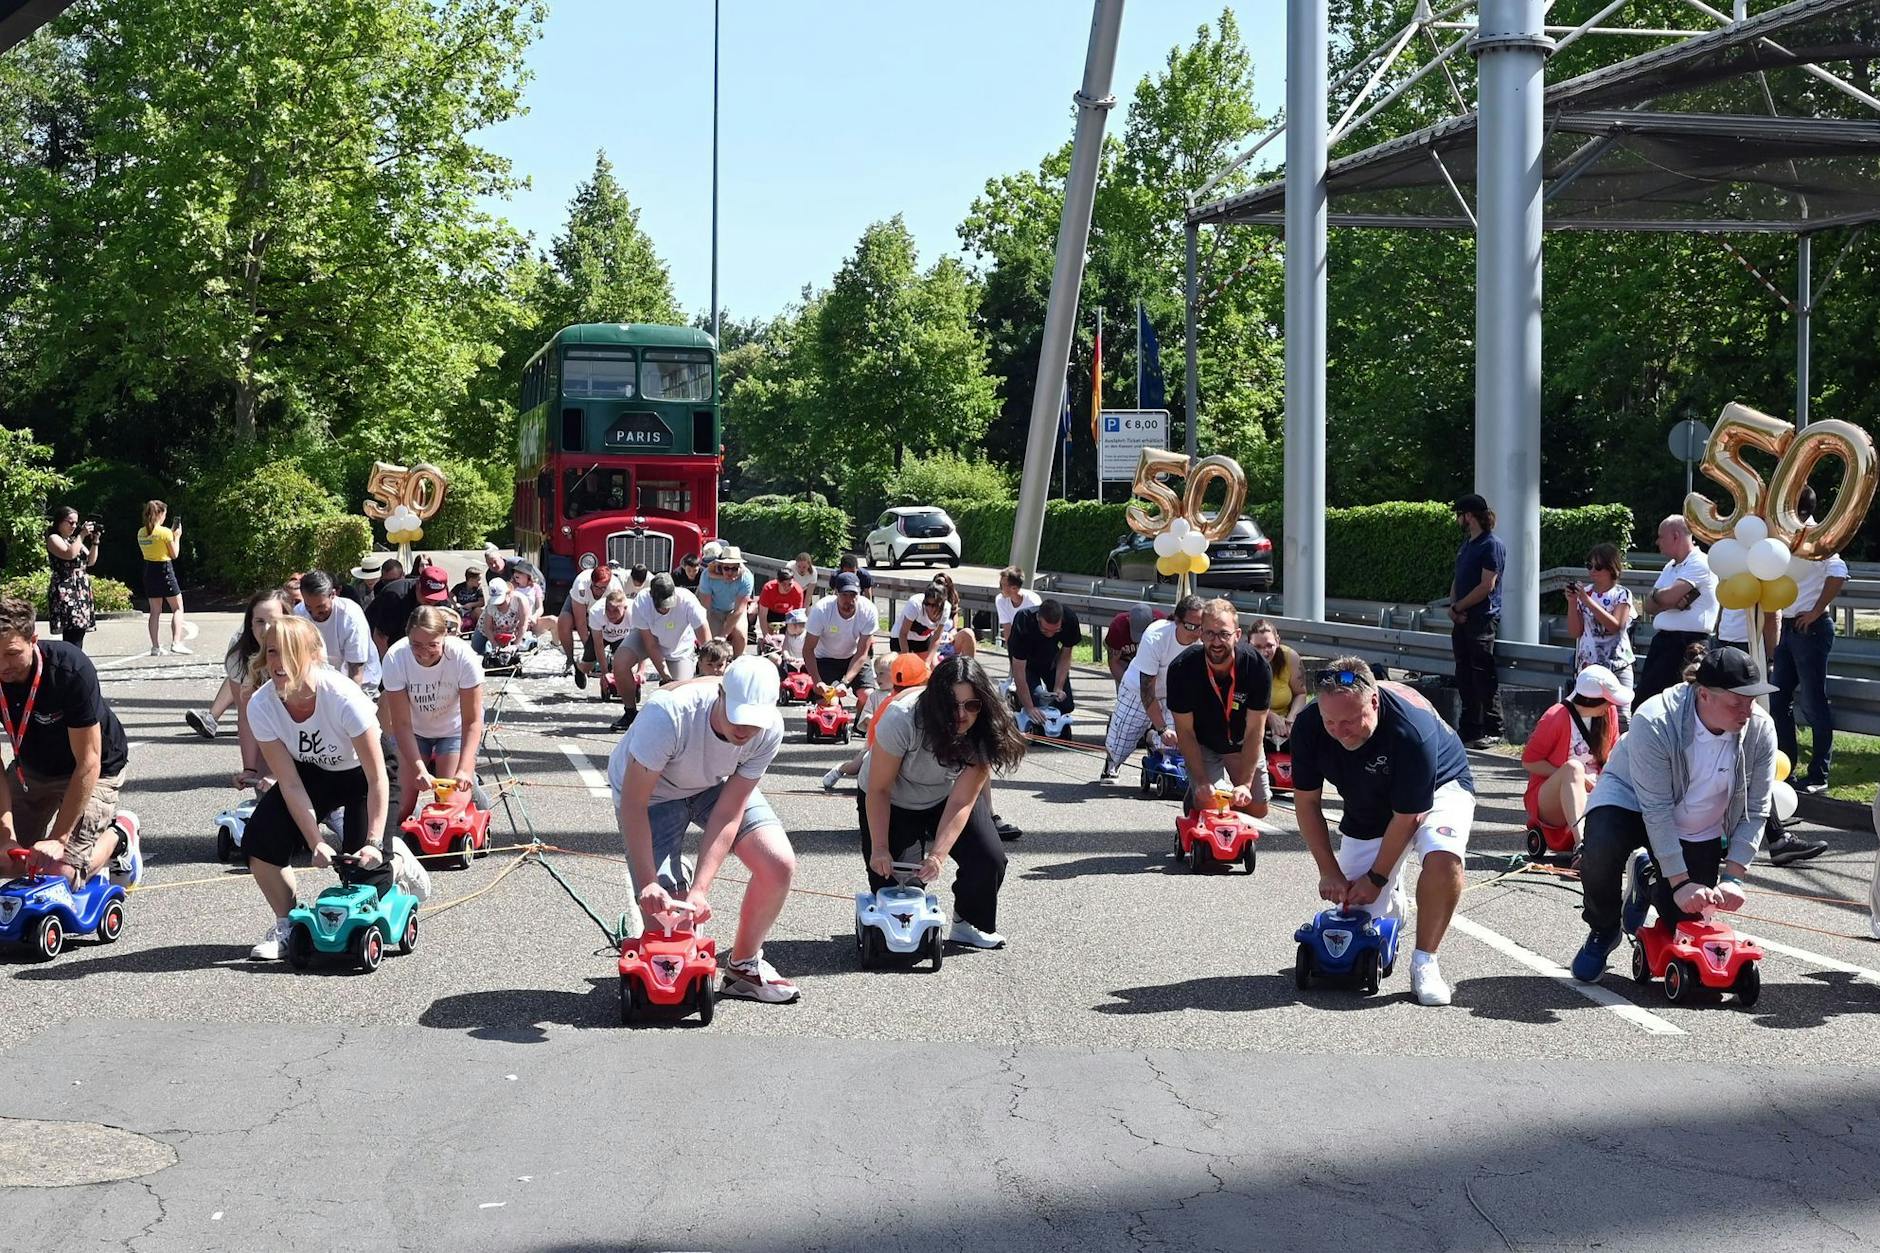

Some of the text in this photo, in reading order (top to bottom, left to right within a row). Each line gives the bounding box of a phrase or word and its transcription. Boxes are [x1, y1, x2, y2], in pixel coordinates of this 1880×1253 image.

[616, 430, 661, 443] PARIS
[1107, 419, 1116, 430] P
[1125, 420, 1158, 431] € 8,00
[362, 460, 448, 520] 50
[1126, 446, 1248, 541] 50
[1683, 401, 1879, 561] 50
[299, 729, 325, 754] BE
